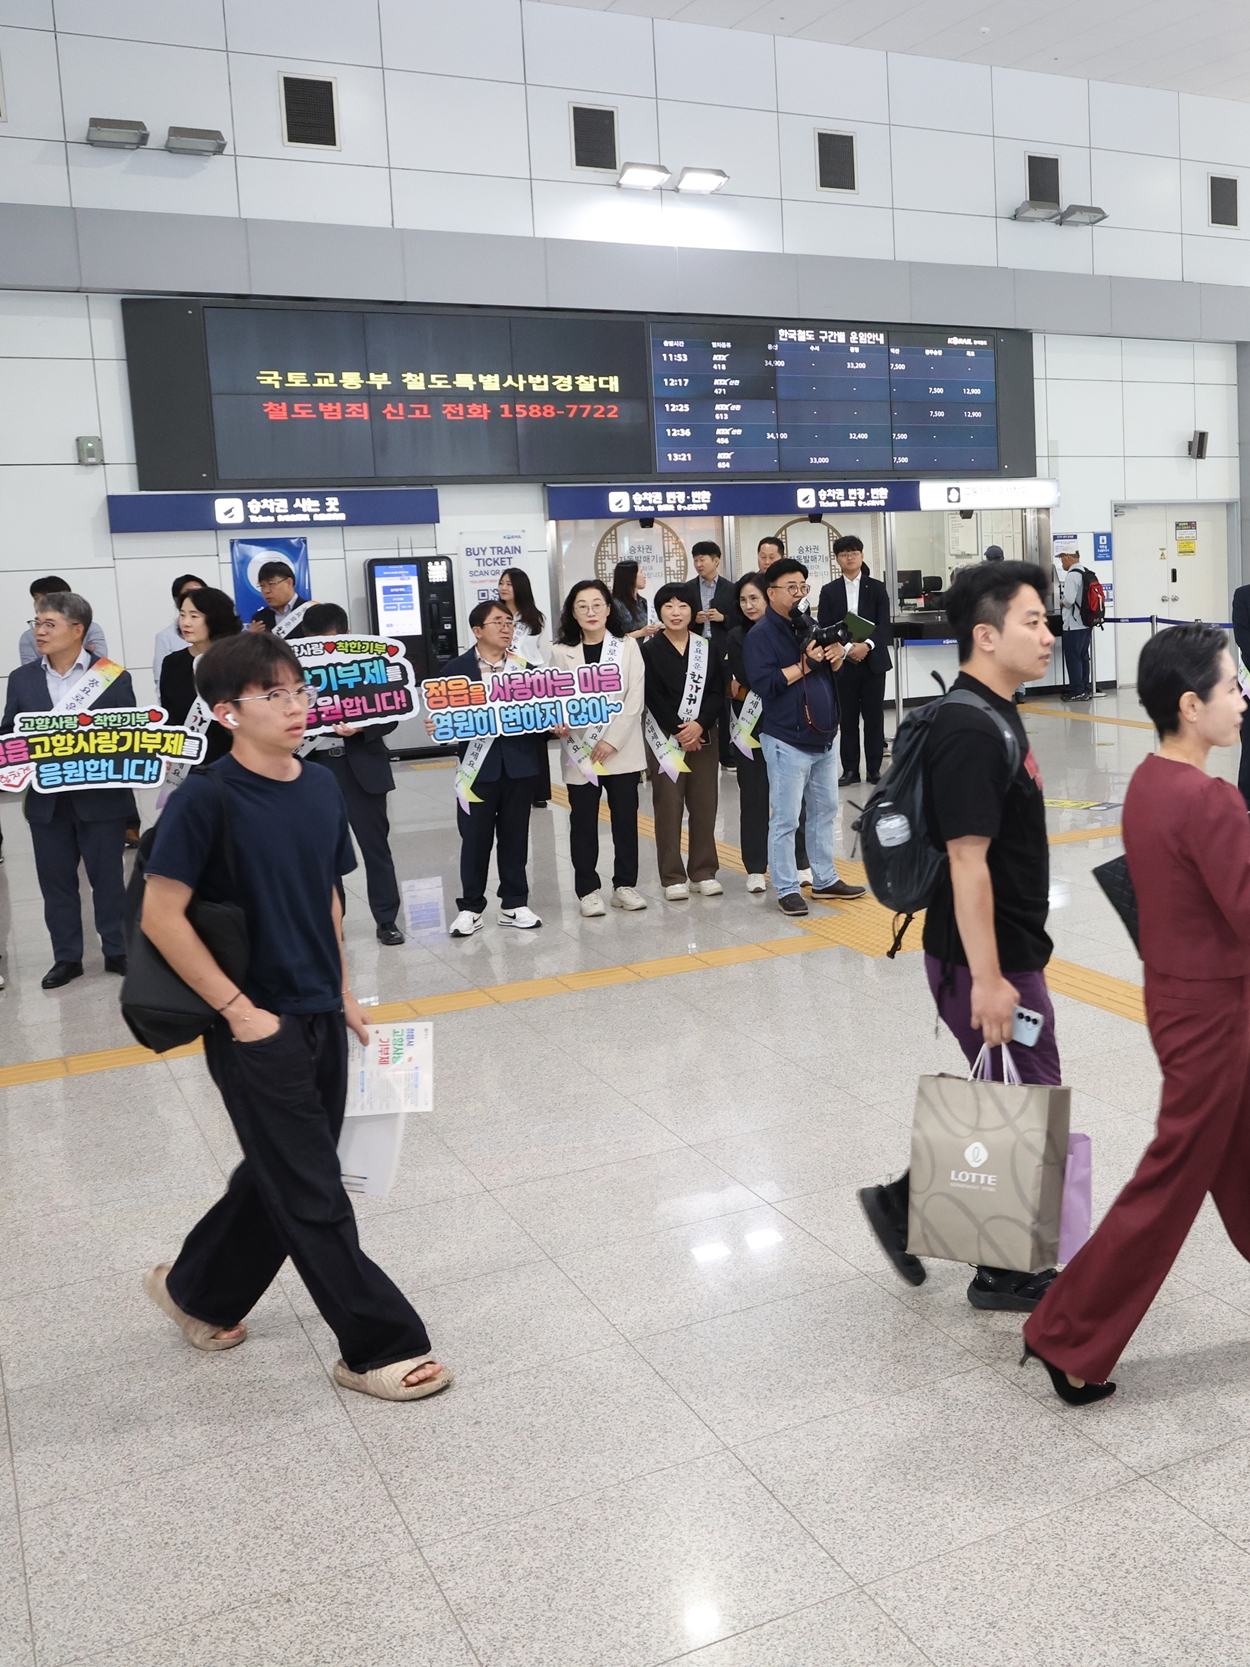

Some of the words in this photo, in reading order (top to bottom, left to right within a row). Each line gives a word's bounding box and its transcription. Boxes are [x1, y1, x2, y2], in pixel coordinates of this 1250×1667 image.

[778, 328, 815, 341] 한국철도
[818, 331, 846, 343] 구간별
[849, 332, 885, 344] 운임안내
[947, 337, 973, 345] KORAIL
[662, 353, 688, 361] 11:53
[256, 370, 392, 390] 국토교통부
[401, 372, 620, 393] 철도특별사법경찰대
[663, 378, 689, 386] 12:17
[262, 401, 369, 421] 철도범죄
[381, 402, 432, 420] 신고
[442, 403, 491, 420] 전화
[499, 404, 619, 419] 1588-7722
[664, 404, 690, 412] 12:25
[666, 428, 691, 437] 12:36
[667, 453, 692, 461] 13:21
[717, 452, 734, 460] KTX
[632, 491, 663, 505] 승차권
[817, 488, 845, 501] 승차권
[247, 498, 289, 514] 승차권
[293, 497, 321, 513] 사는
[325, 497, 340, 512] 곳
[818, 500, 838, 508] Tickets
[465, 546, 488, 557] BUY
[489, 545, 522, 556] TRAIN
[629, 544, 653, 554] 승차권
[797, 544, 820, 554] 승차권
[475, 556, 513, 567] TICKET
[336, 640, 387, 655] 착한기부
[692, 639, 705, 671] 풍요로운
[304, 658, 403, 693] 기부제를
[64, 677, 100, 711] 풍요로운
[424, 678, 486, 710] 정읍을
[489, 670, 575, 703] 사랑하는
[577, 664, 622, 693] 마음
[685, 671, 704, 706] 한가위
[20, 715, 79, 732] 고향사랑
[93, 711, 150, 728] 착한기부
[432, 706, 497, 741] 영원히
[500, 701, 563, 733] 변하지
[38, 758, 160, 787] 응원합니다!
[406, 1028, 415, 1047] 정읍시
[378, 1037, 390, 1066] 기부제
[950, 1170, 998, 1186] LOTTE
